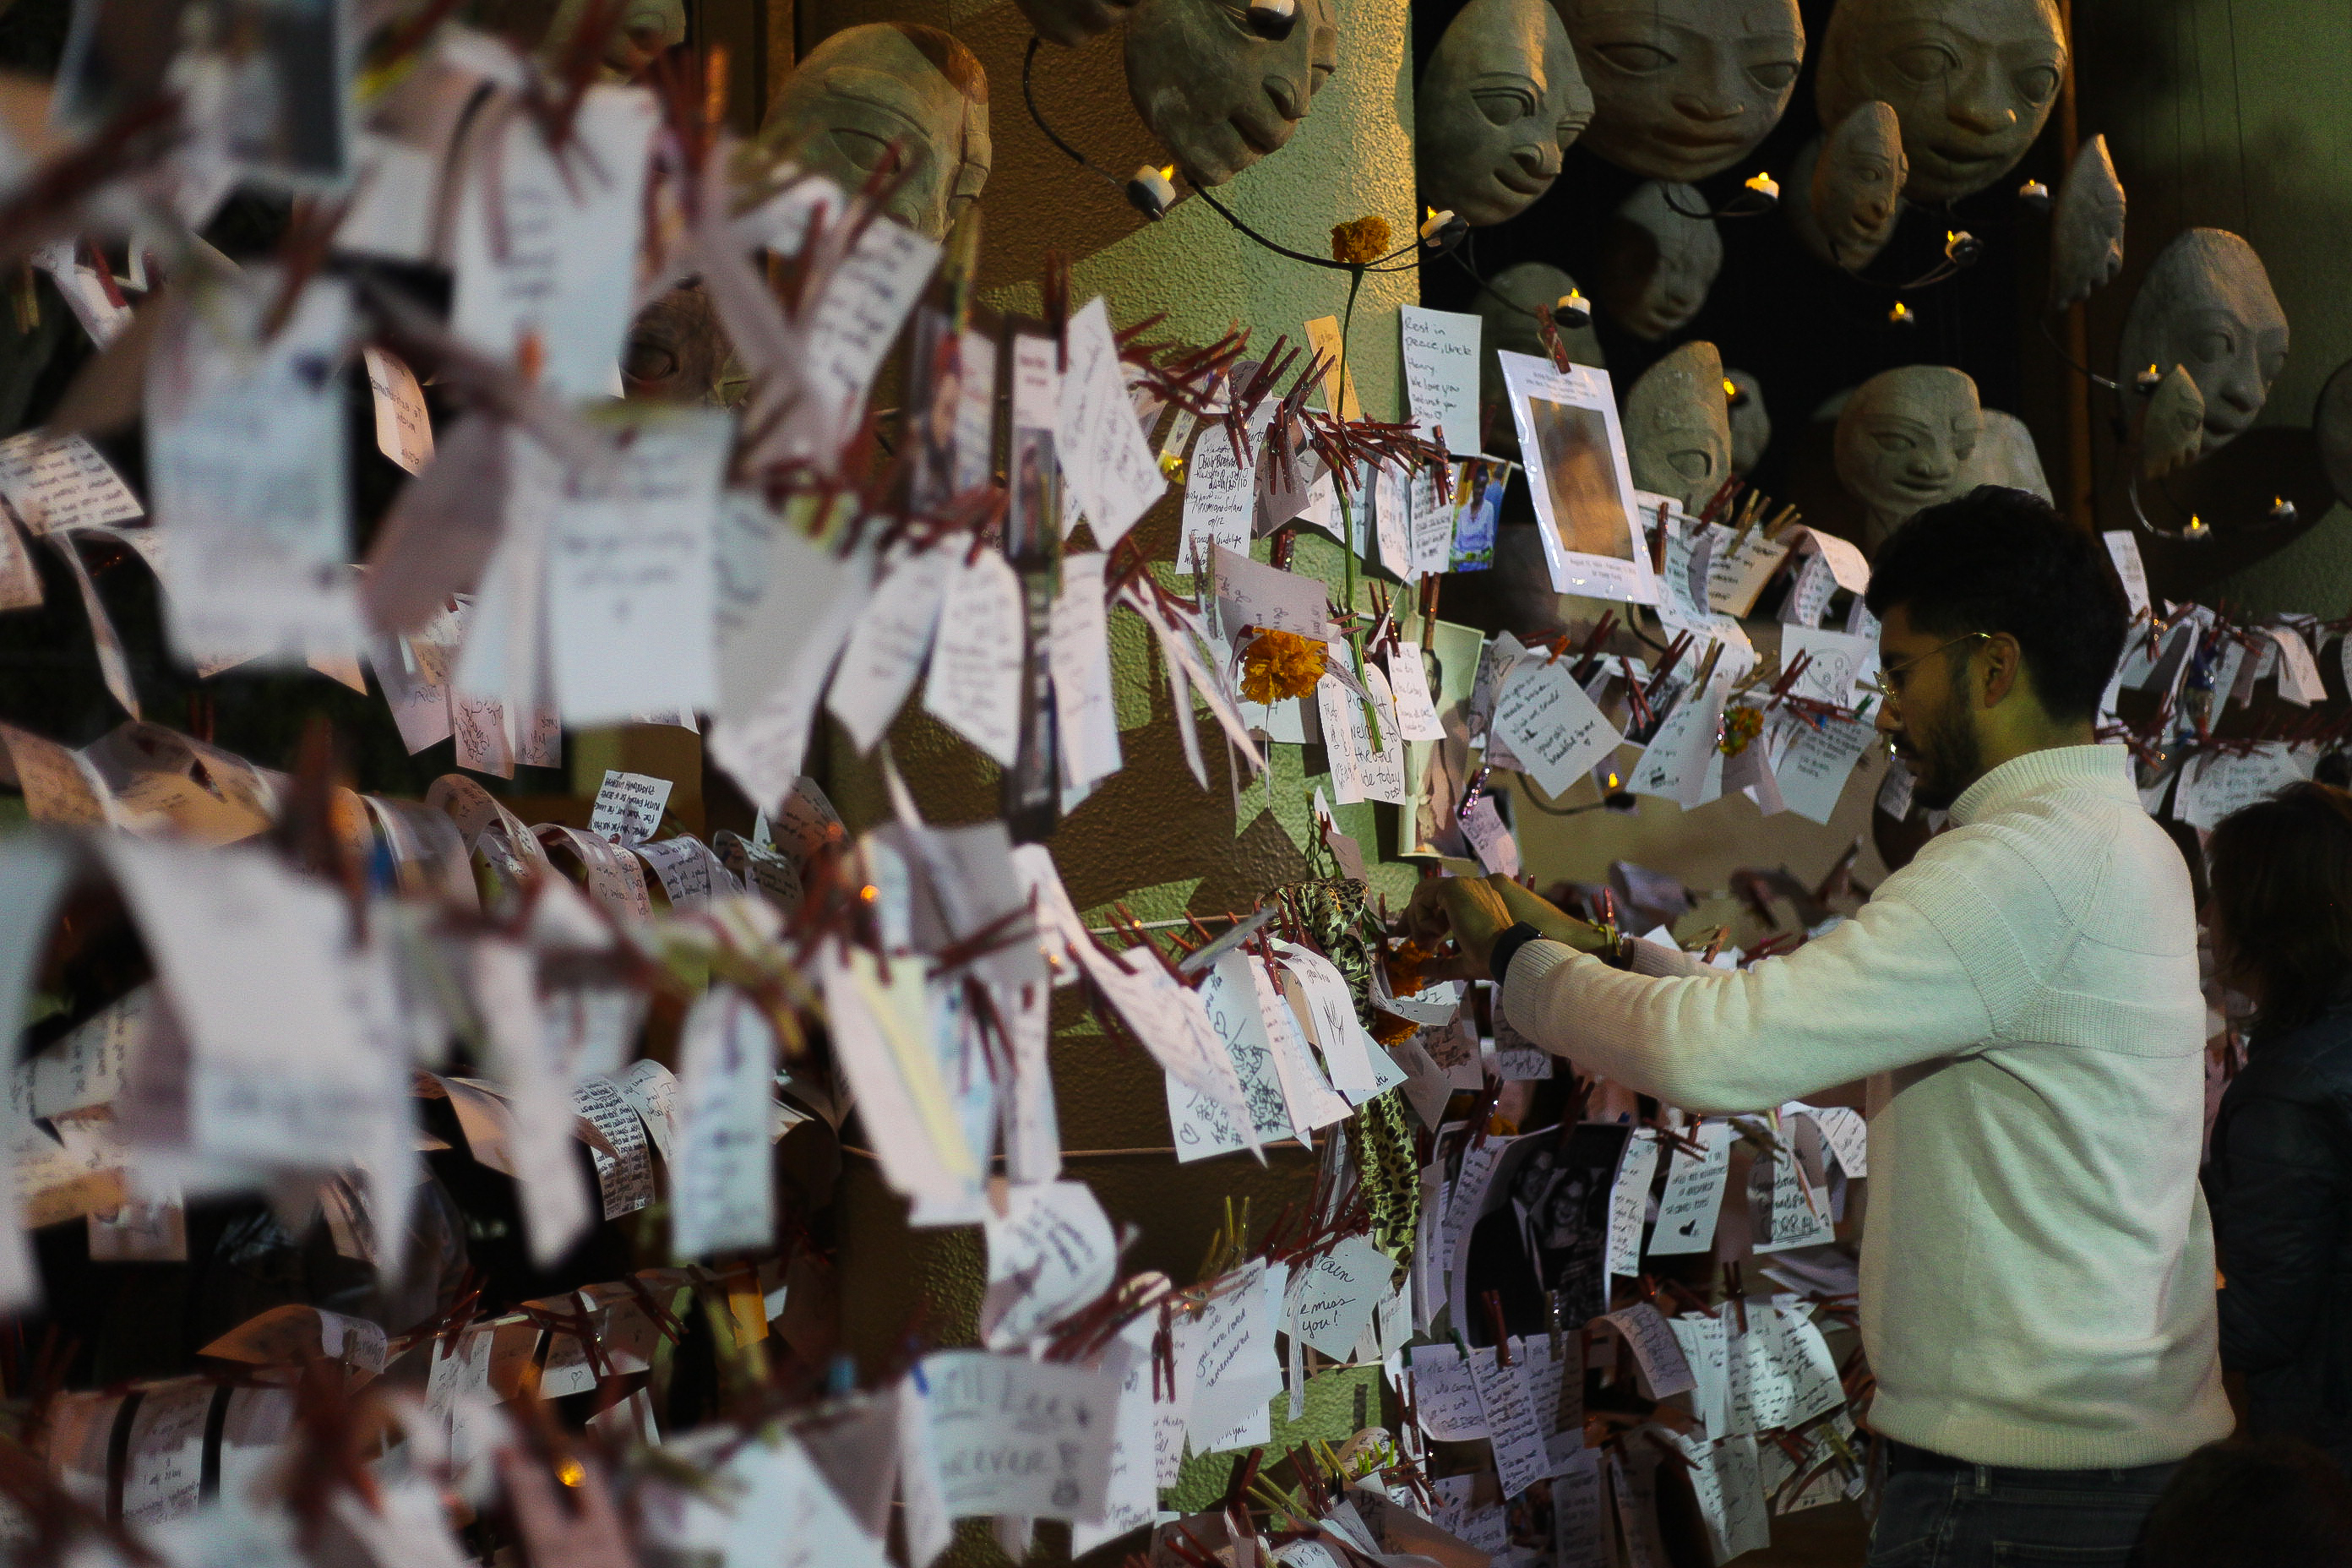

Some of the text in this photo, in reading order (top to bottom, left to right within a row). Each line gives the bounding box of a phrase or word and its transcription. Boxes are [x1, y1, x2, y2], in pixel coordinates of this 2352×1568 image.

[1434, 324, 1446, 335] in
[1376, 767, 1401, 791] today
[1309, 1298, 1356, 1315] miss
